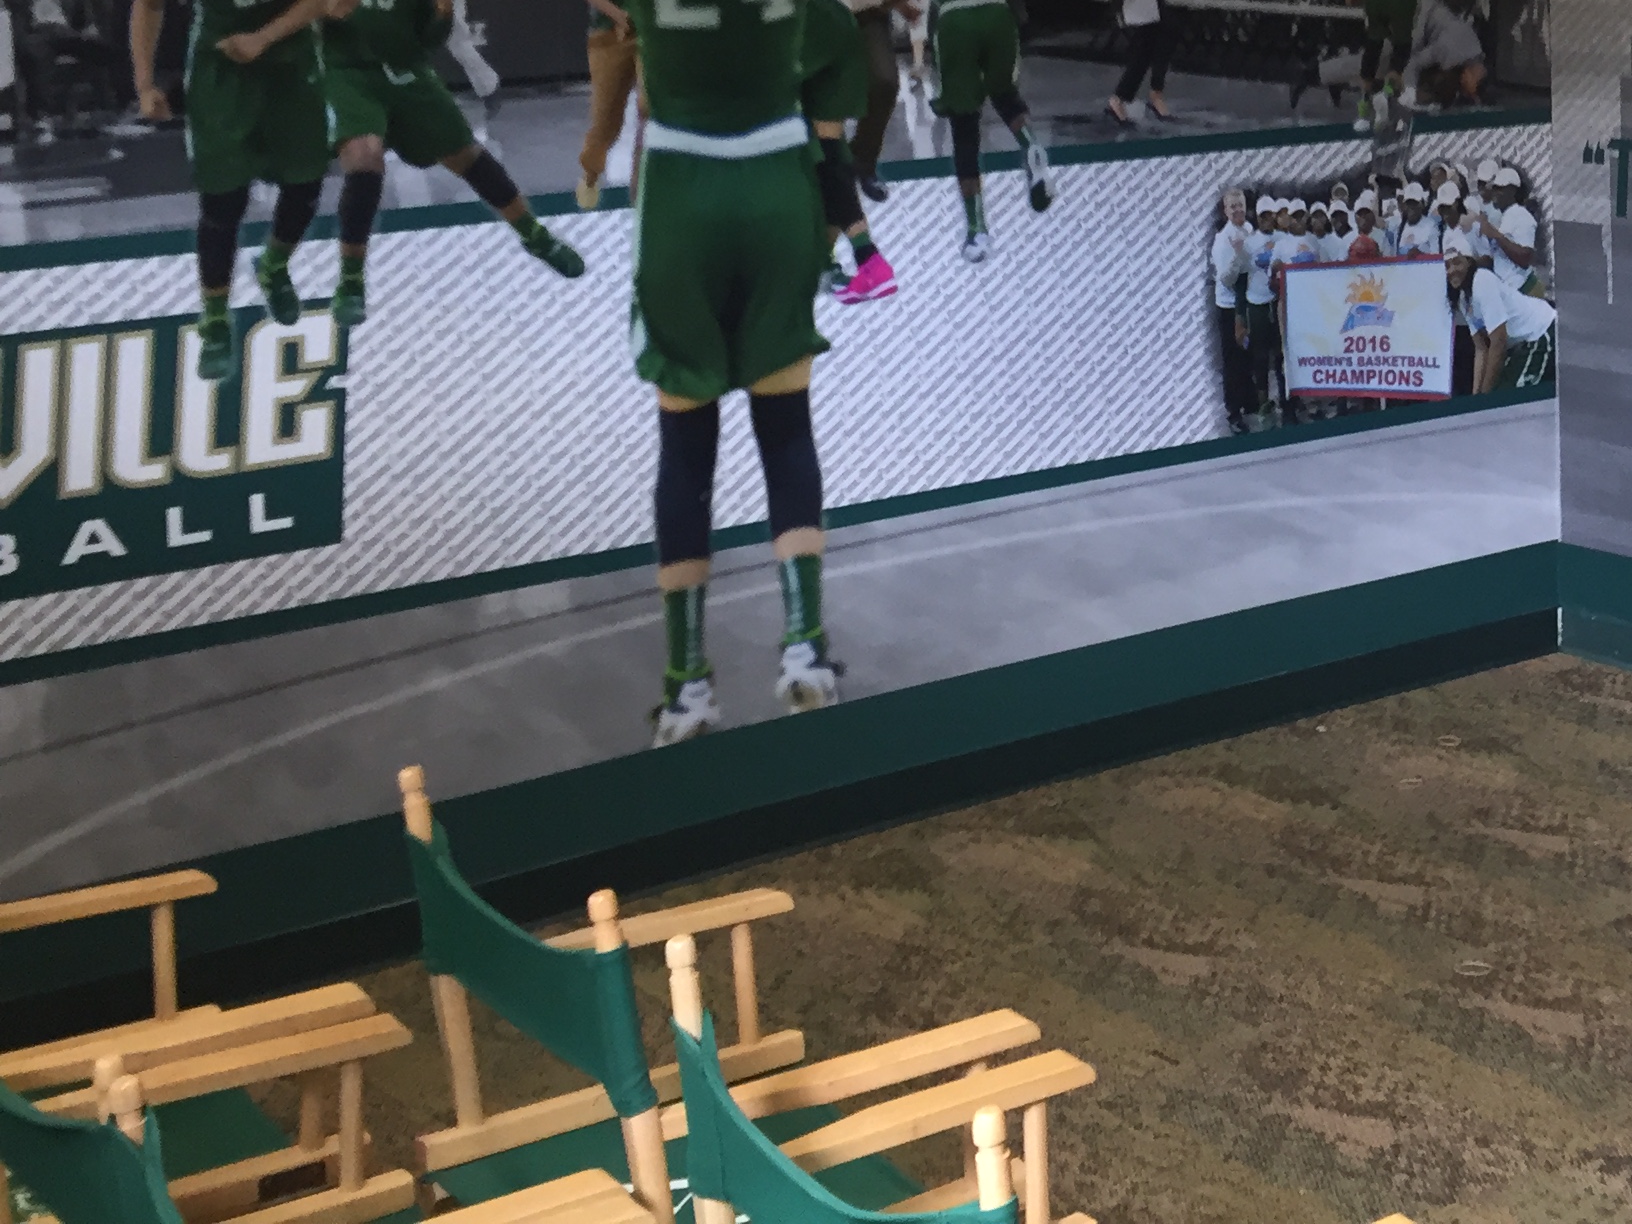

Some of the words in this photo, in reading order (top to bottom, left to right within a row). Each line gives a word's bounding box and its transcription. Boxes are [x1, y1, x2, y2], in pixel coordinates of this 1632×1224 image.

[1343, 335, 1391, 353] 2016
[1297, 355, 1353, 368] WOMEN'S
[1357, 356, 1440, 368] BASKETBALL
[1312, 368, 1423, 387] CHAMPIONS
